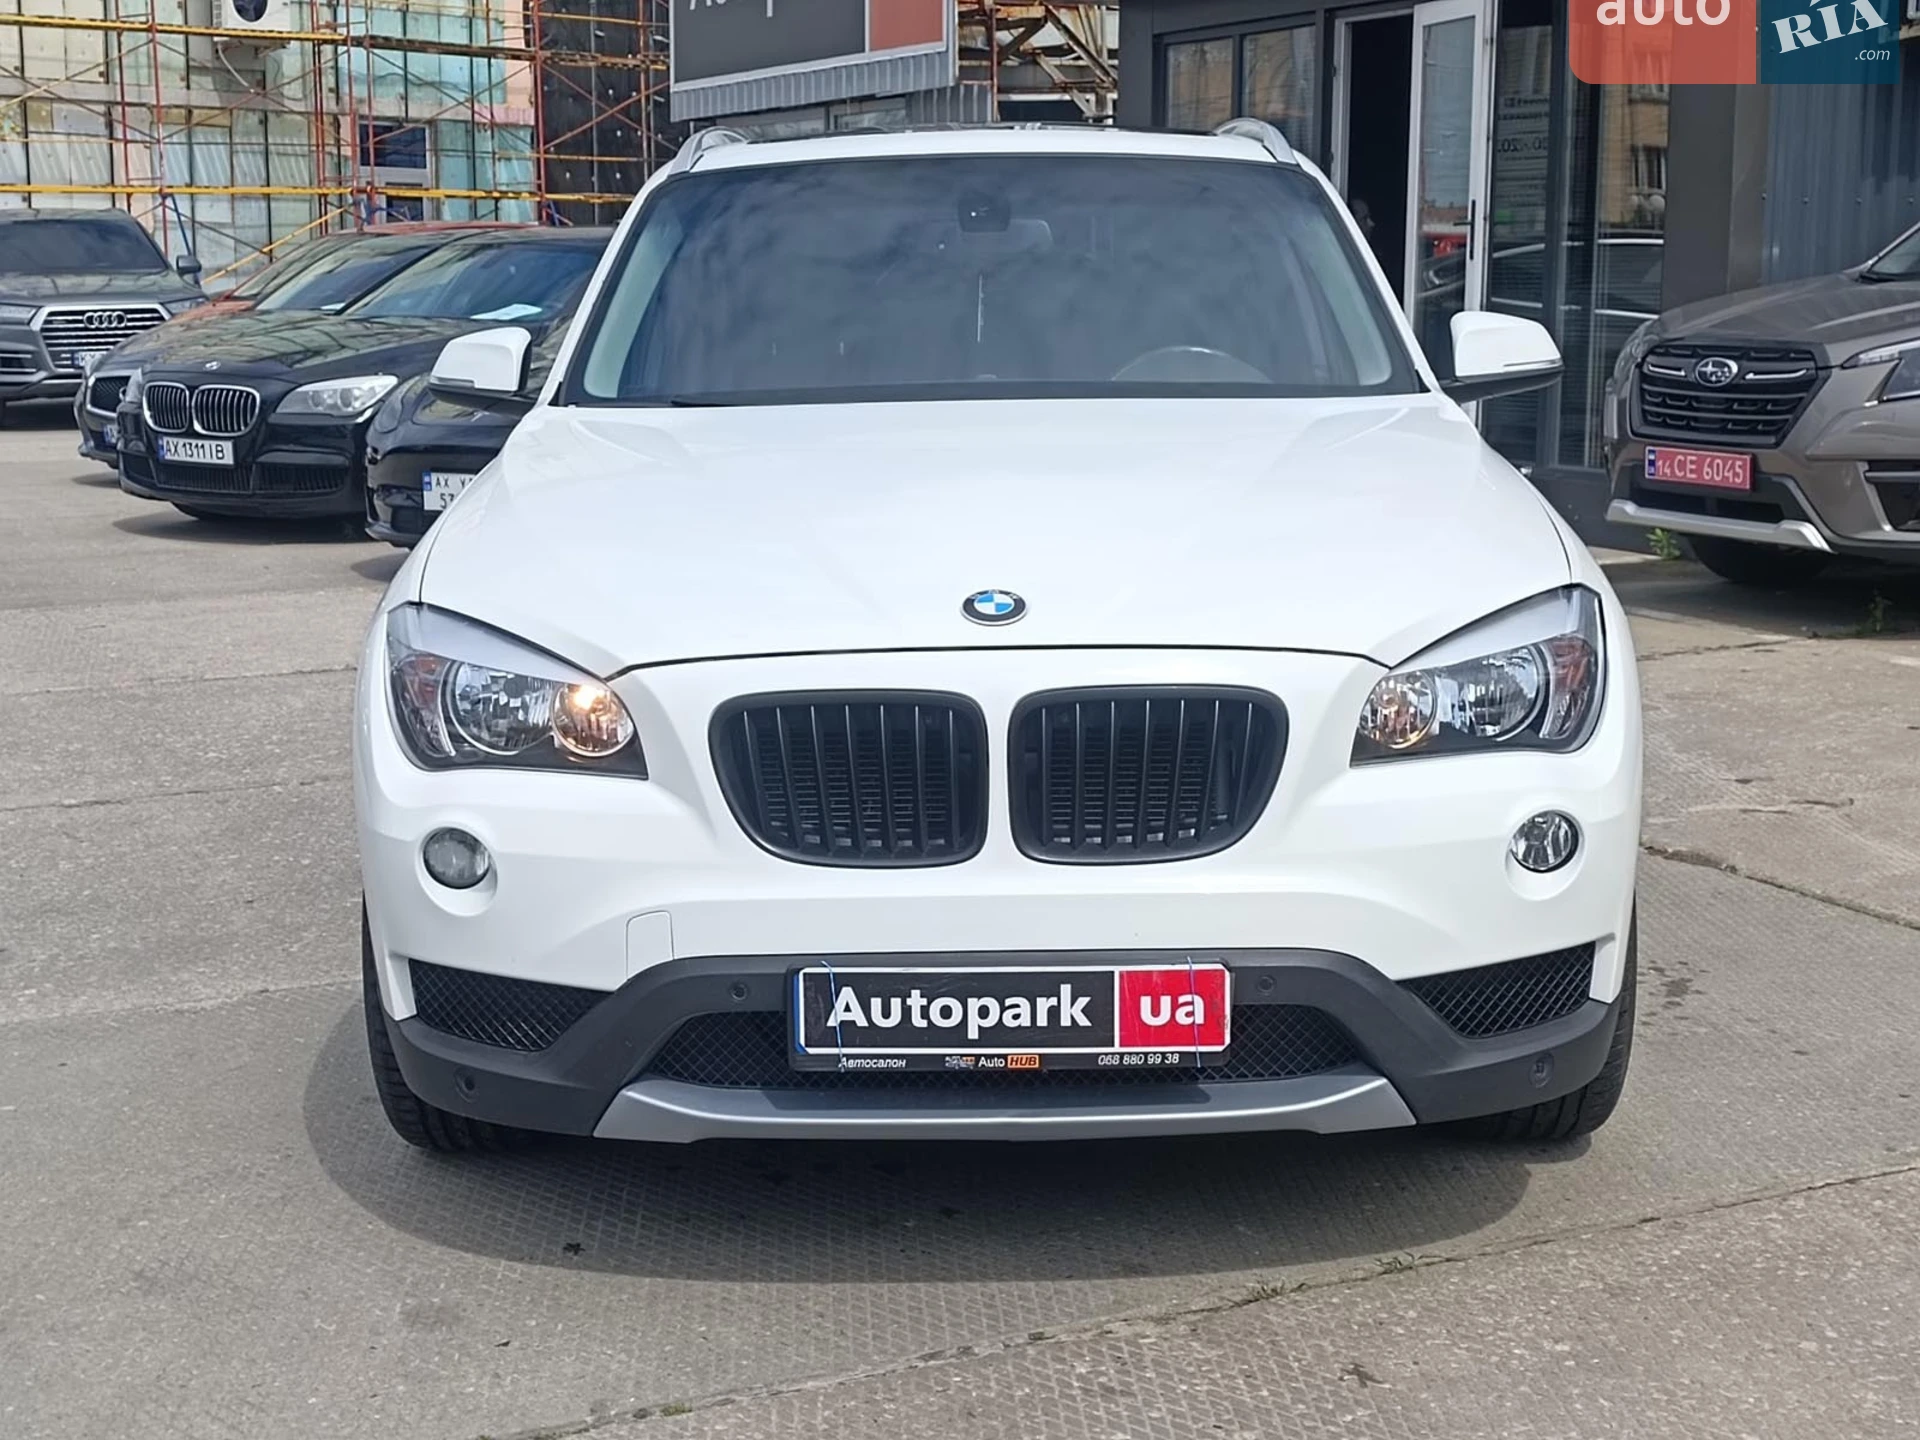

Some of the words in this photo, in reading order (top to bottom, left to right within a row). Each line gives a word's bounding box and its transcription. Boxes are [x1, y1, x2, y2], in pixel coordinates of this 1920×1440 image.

[1702, 457, 1744, 484] 6045
[826, 983, 1092, 1040] Autopark
[1138, 992, 1205, 1026] ua
[838, 1057, 907, 1068] Автосалон
[978, 1056, 1006, 1068] Auto
[1009, 1056, 1038, 1067] HUB
